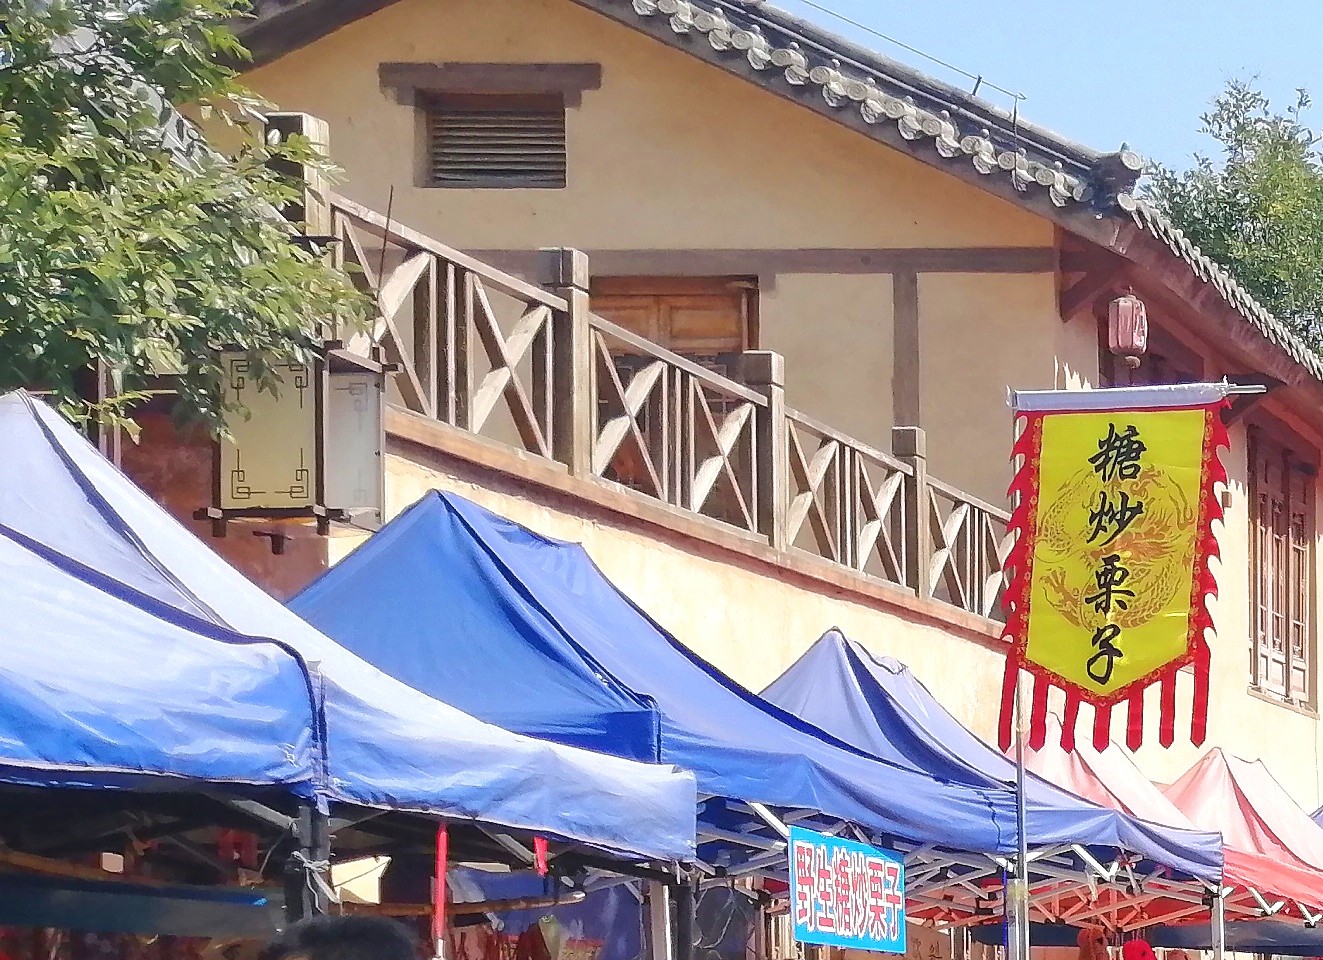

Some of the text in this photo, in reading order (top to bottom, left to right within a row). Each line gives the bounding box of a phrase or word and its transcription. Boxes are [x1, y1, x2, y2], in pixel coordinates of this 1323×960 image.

[1085, 423, 1147, 685] 糖炒栗子
[794, 841, 903, 941] 野生糖炒栗子
